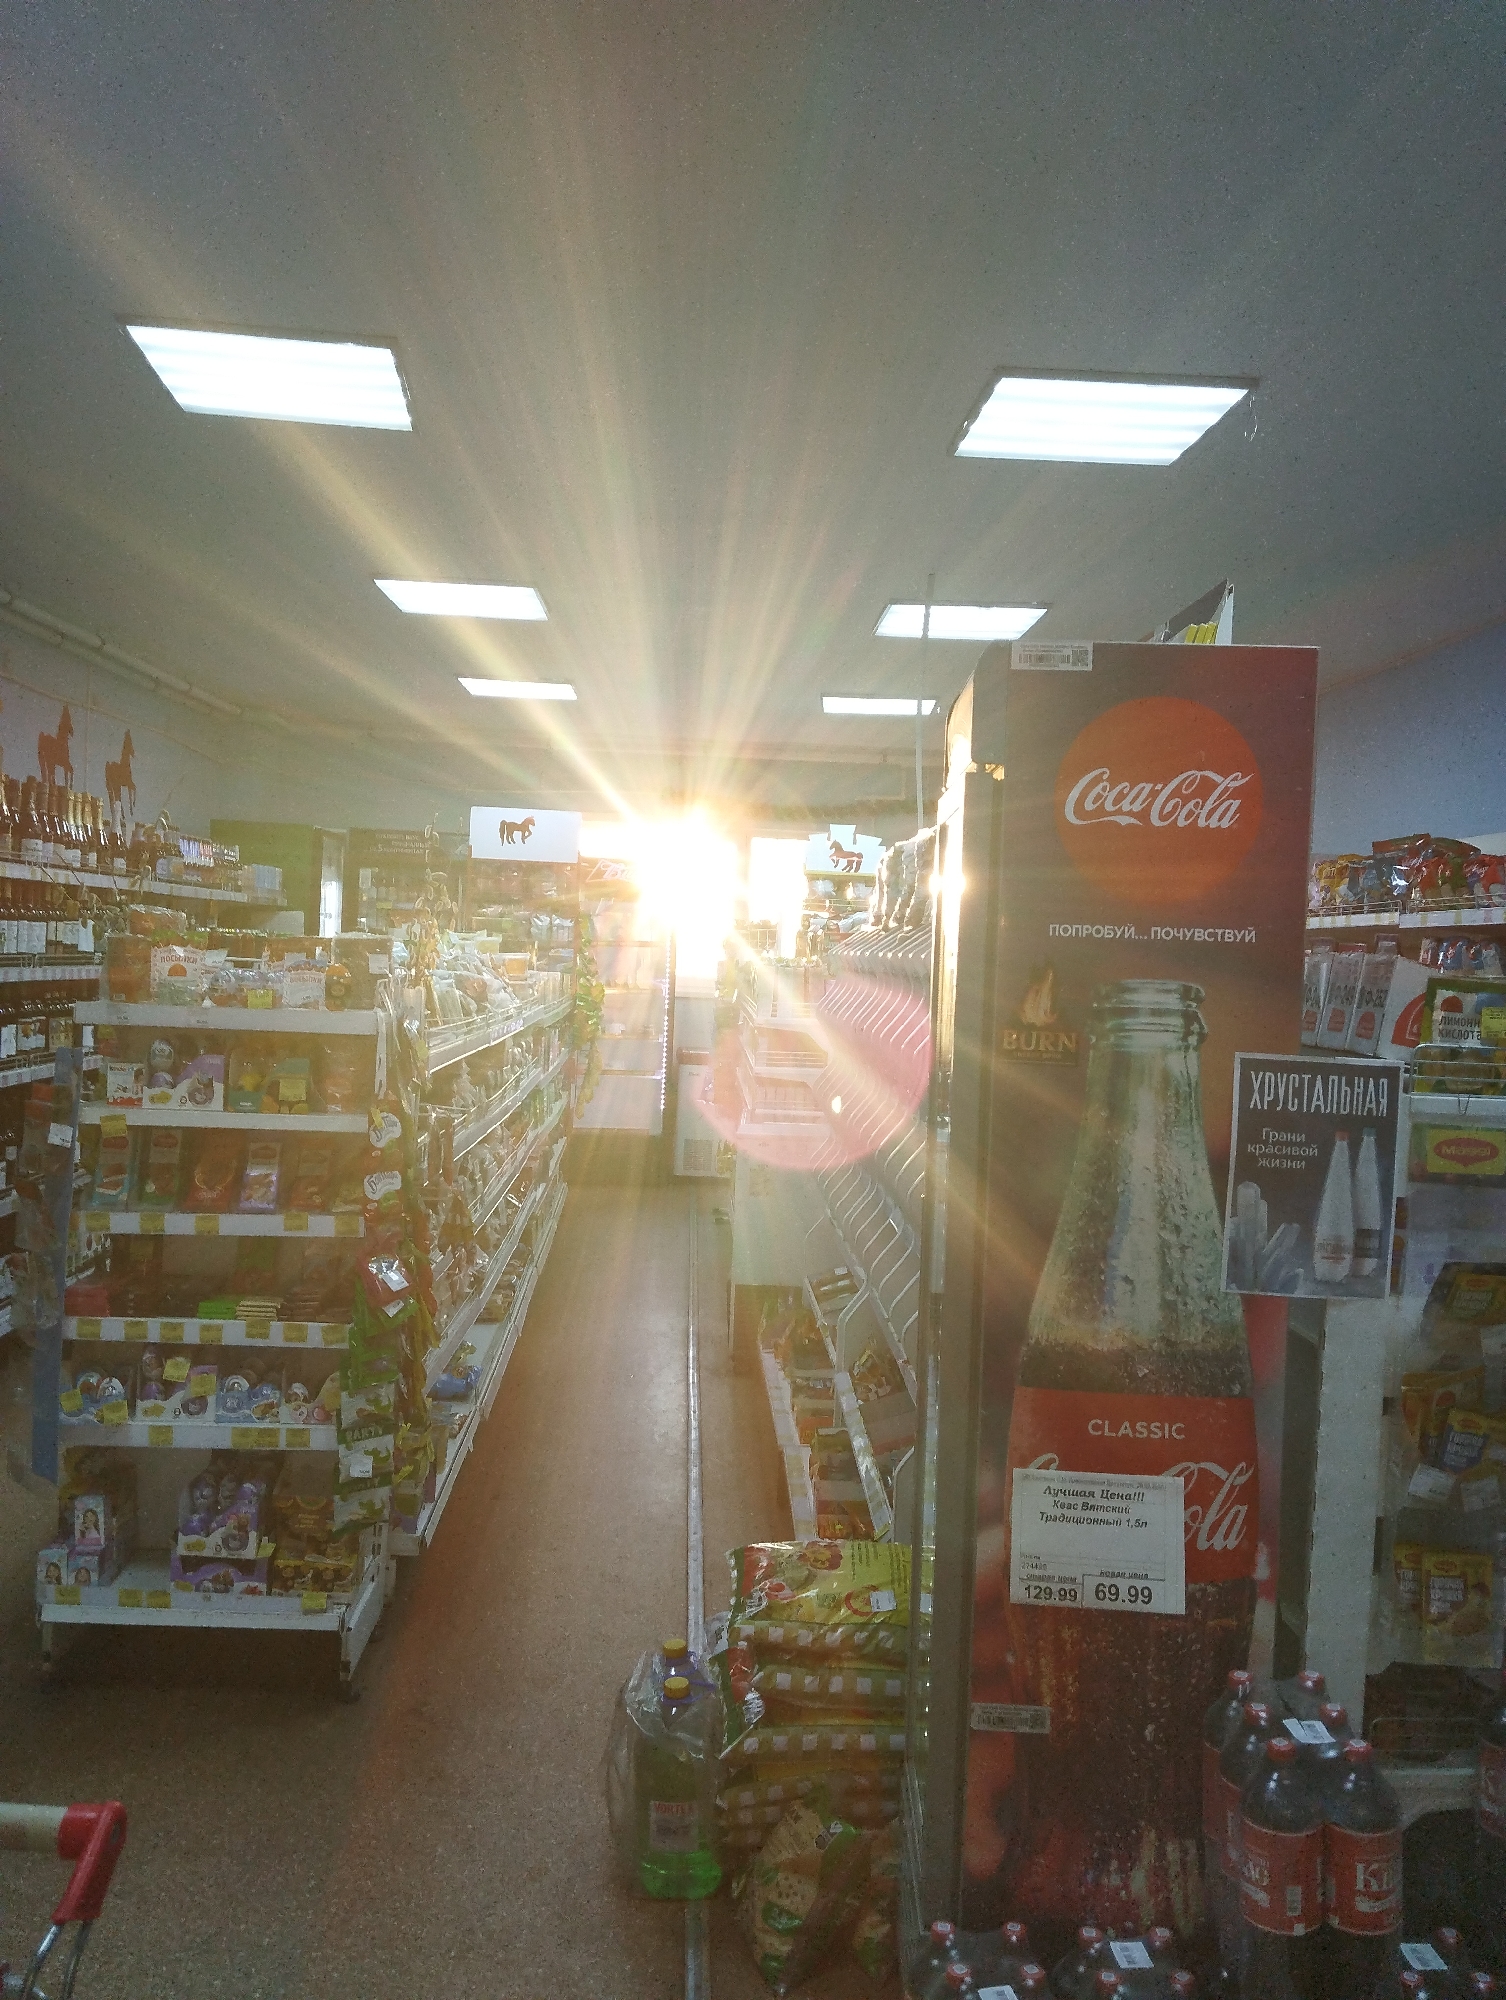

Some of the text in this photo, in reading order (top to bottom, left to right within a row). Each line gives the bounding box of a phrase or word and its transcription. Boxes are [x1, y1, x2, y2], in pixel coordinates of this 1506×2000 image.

[1064, 766, 1255, 830] Coca-Cola
[1048, 922, 1257, 944] ПОПРОБУЙ... ПОЧУВСТВУЙ
[1002, 1029, 1077, 1053] BURN
[1249, 1070, 1389, 1117] ХРУСТАЛЬНАЯ
[1261, 1127, 1306, 1143] Грани
[1247, 1143, 1318, 1157] красивой
[1258, 1157, 1306, 1170] жизни
[1087, 1419, 1186, 1440] CLASSIC
[1043, 1485, 1145, 1502] Лучшая Цена!!!
[1052, 1500, 1131, 1515] Квас Вятский
[1039, 1511, 1148, 1530] Традиционный 1,5л
[1024, 1583, 1153, 1606] 129.99 69.99
